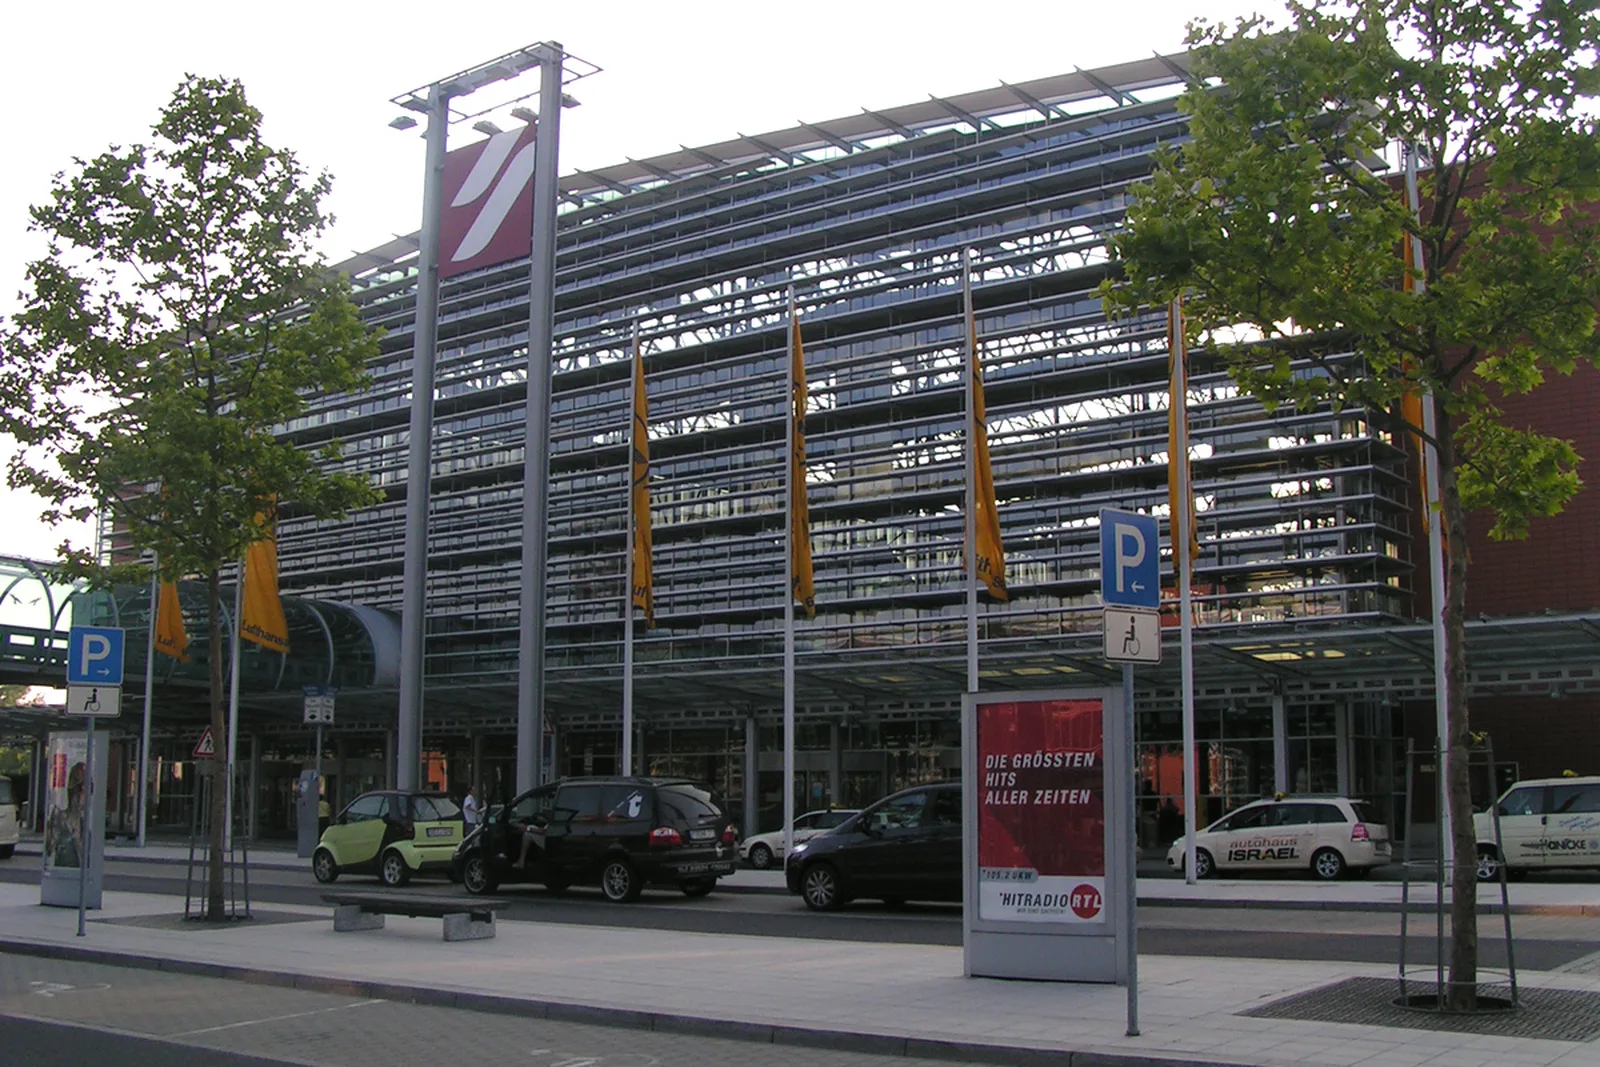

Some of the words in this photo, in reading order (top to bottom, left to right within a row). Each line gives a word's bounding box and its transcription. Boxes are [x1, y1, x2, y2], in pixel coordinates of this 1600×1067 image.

[1115, 523, 1146, 593] P
[81, 634, 111, 676] P
[985, 754, 1008, 769] DIE
[1012, 750, 1095, 768] GRÖSSTEN
[985, 772, 1017, 787] HITS
[985, 790, 1029, 805] ALLER
[1034, 789, 1091, 804] ZEITEN
[1229, 838, 1297, 848] autohaus
[1228, 847, 1299, 862] ISRAEL
[1072, 894, 1102, 908] RTL
